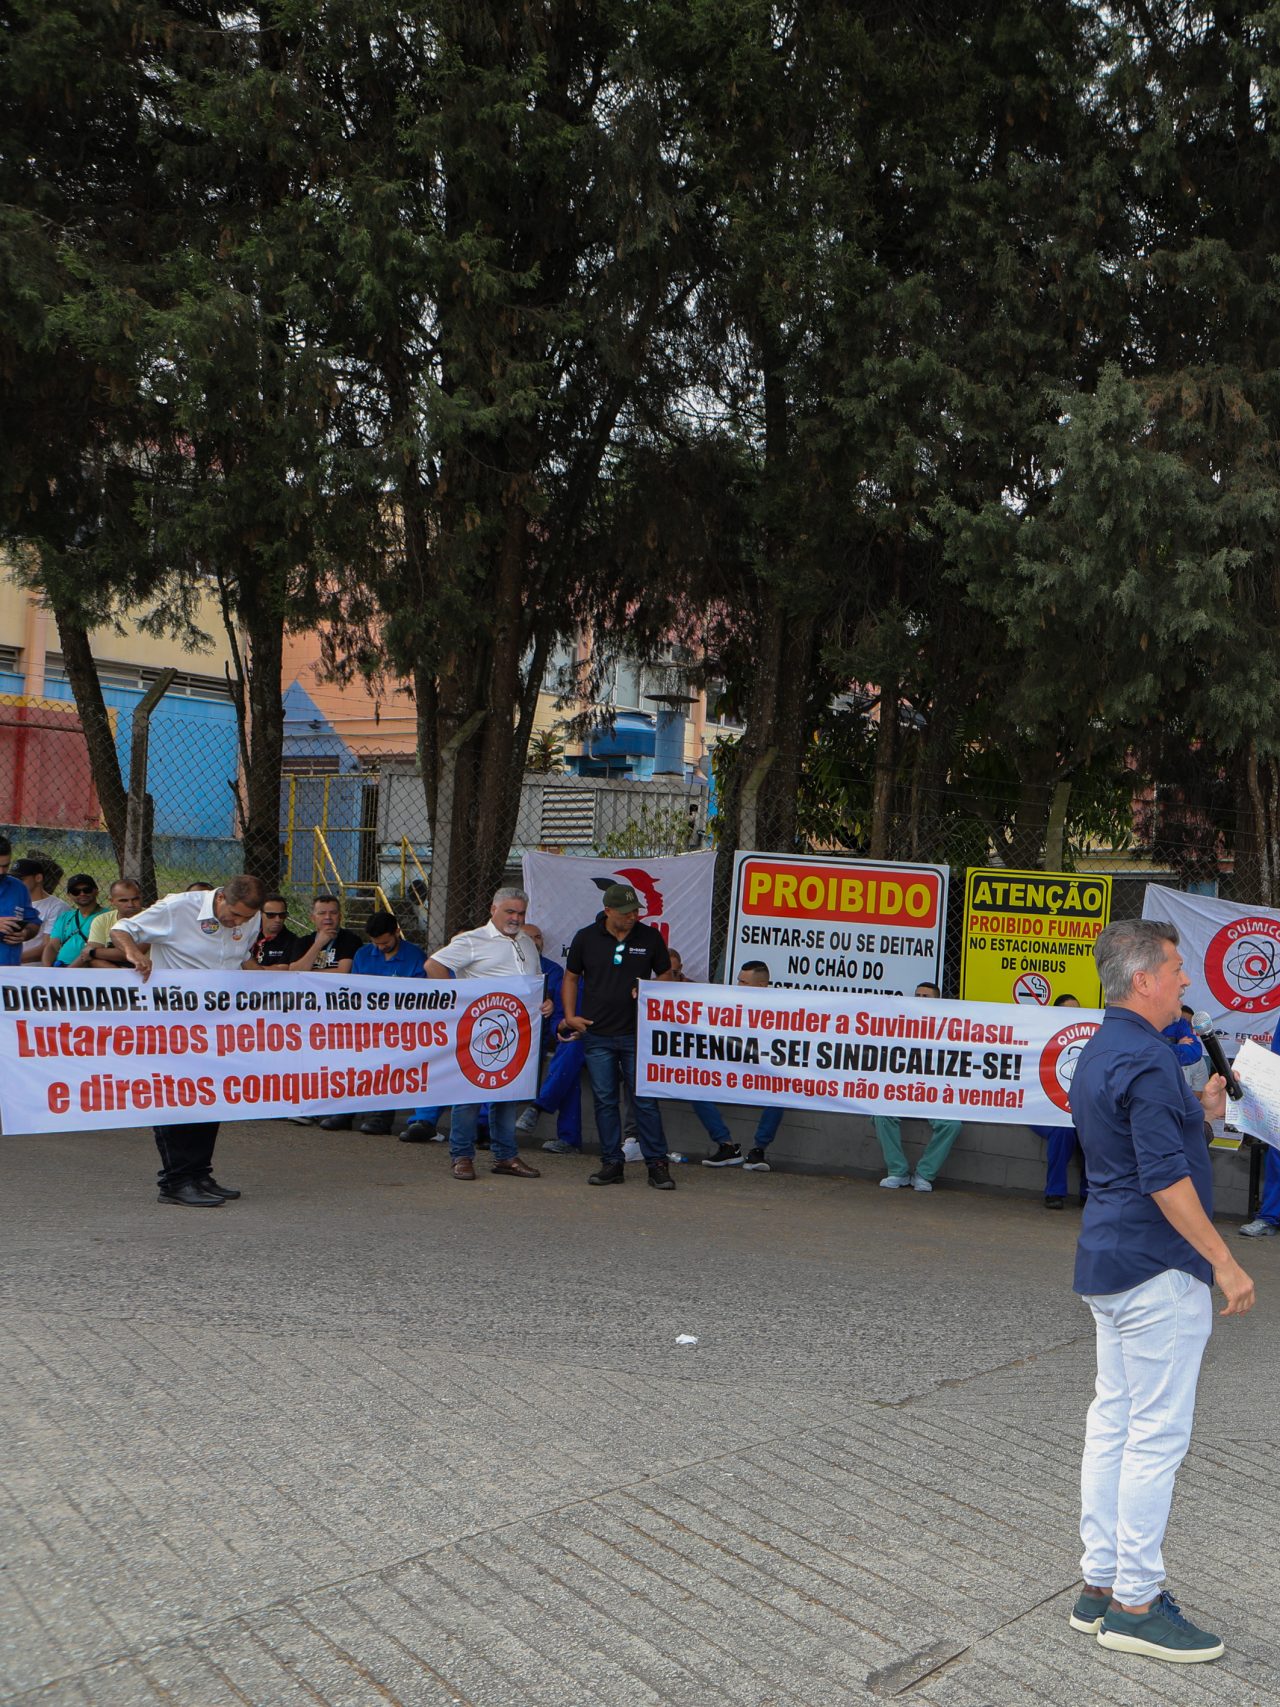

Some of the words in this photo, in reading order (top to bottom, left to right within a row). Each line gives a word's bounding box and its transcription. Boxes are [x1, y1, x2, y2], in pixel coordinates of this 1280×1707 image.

[749, 872, 931, 918] PROIBIDO
[974, 882, 1102, 915] ATENÇÃO
[741, 925, 825, 949] SENTAR-SE
[829, 931, 851, 951] OU
[856, 933, 875, 952] SE
[880, 936, 934, 958] DEITAR
[969, 915, 1043, 936] PROIBIDO
[1048, 919, 1103, 939] FUMAR
[969, 937, 986, 950] NO
[991, 938, 1096, 957] ESTACIONAMENT
[788, 955, 810, 975] NO
[815, 955, 858, 979] CHÃO
[863, 961, 883, 980] DO
[1001, 957, 1016, 970] DE
[1021, 956, 1066, 973] ÔNIBUS
[2, 985, 148, 1012] DIGNIDADE:
[153, 985, 199, 1012] Não
[203, 990, 231, 1011] se
[235, 989, 321, 1013] compra,
[325, 987, 361, 1011] não
[367, 991, 389, 1010] se
[394, 989, 457, 1011] vende!
[471, 995, 521, 1018] QUÍMICOS
[16, 1020, 209, 1058] Lutaremos
[216, 1018, 302, 1057] pelos
[309, 1020, 449, 1052] empregos
[647, 998, 703, 1025] BASF
[708, 1004, 743, 1028] vai
[748, 1008, 831, 1033] vender
[835, 1014, 849, 1034] a
[855, 1011, 1029, 1046] Suvinil/Glasu...
[1057, 1024, 1096, 1046] QUÍMI
[652, 1030, 811, 1068] DEFENDA-SE!
[816, 1041, 1022, 1081] SINDICALIZE-SE!
[47, 1081, 70, 1114] e
[80, 1073, 217, 1113] direitos
[223, 1061, 429, 1104] conquistados!
[647, 1063, 722, 1088] Direitos
[726, 1071, 738, 1088] e
[742, 1073, 839, 1098] empregos
[843, 1078, 879, 1100] não
[884, 1078, 938, 1103] estão
[942, 1084, 952, 1104] à
[958, 1088, 1024, 1109] venda!
